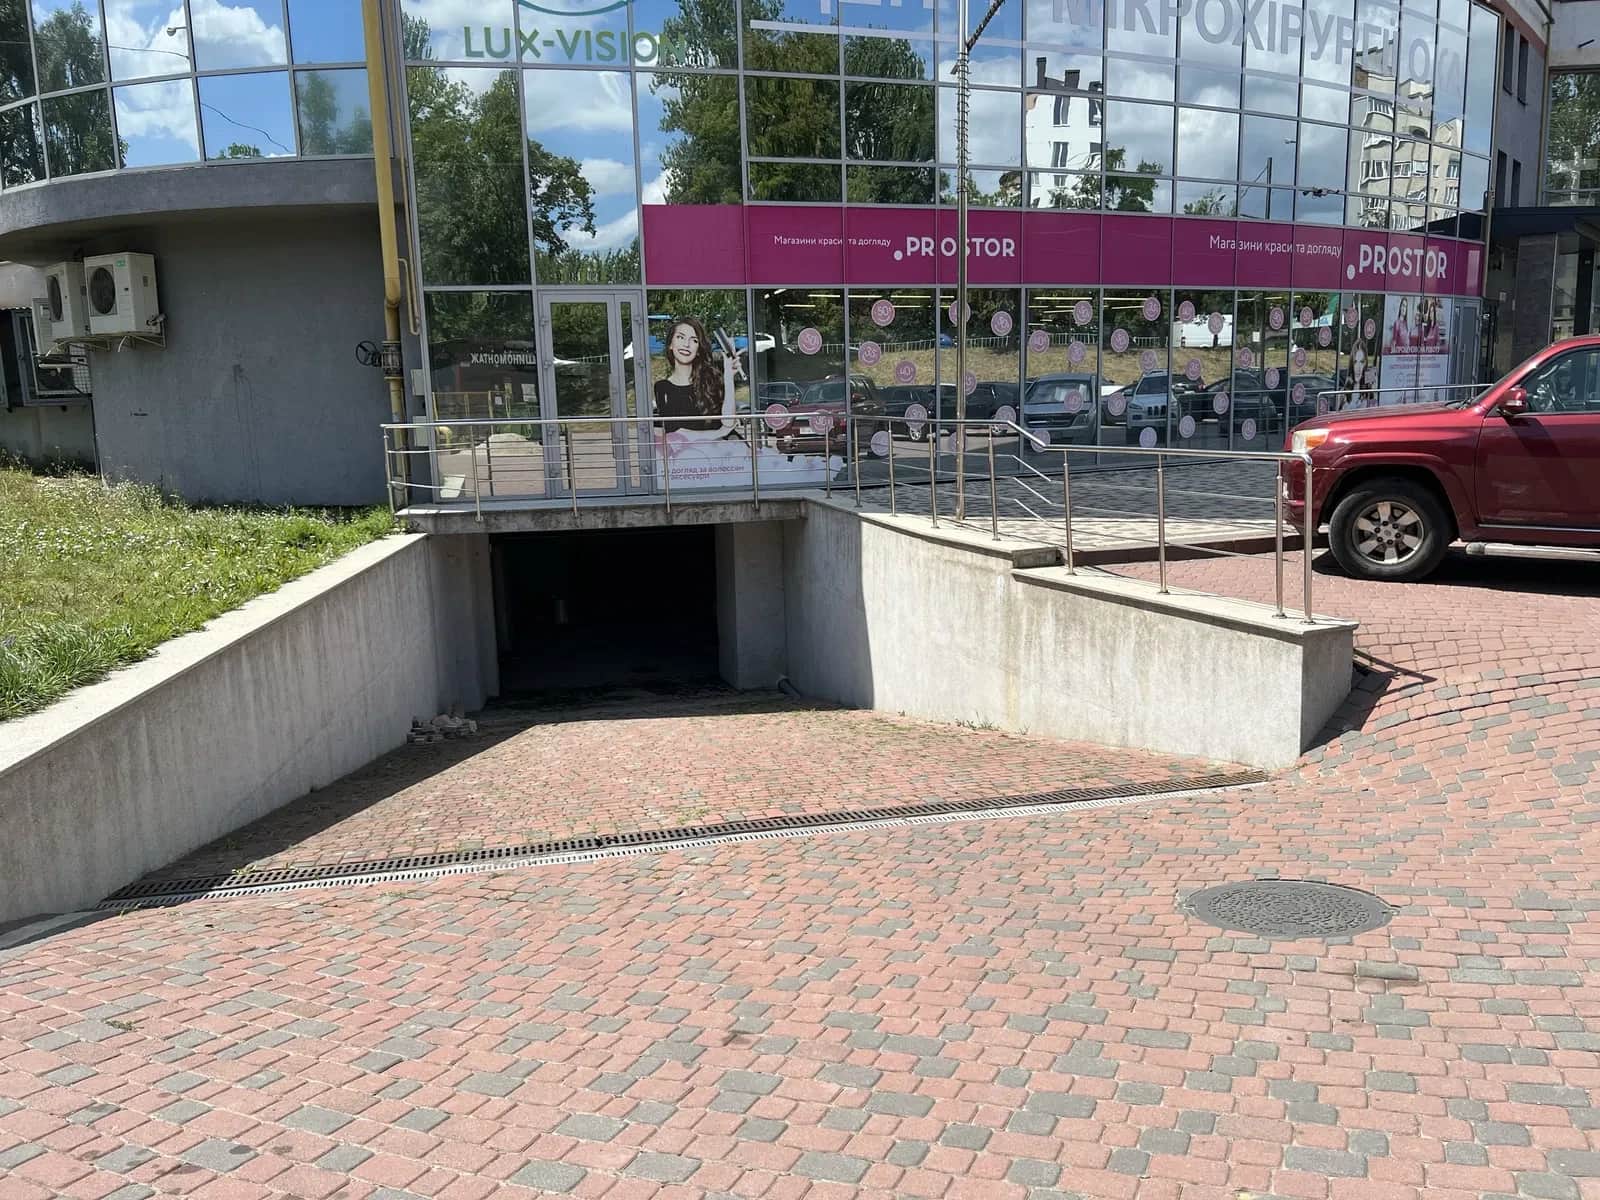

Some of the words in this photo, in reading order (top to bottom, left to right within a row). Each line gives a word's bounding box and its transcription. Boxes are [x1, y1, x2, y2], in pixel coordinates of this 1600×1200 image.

[463, 26, 685, 63] LUX-VISION
[774, 235, 817, 246] Магазини
[818, 238, 844, 247] краси
[848, 238, 857, 246] та
[858, 238, 891, 248] догляду
[1210, 235, 1263, 251] Магазини
[1264, 241, 1293, 255] краси
[1295, 243, 1305, 254] та
[1307, 244, 1342, 259] догляду
[1358, 244, 1448, 279] PROSTOR
